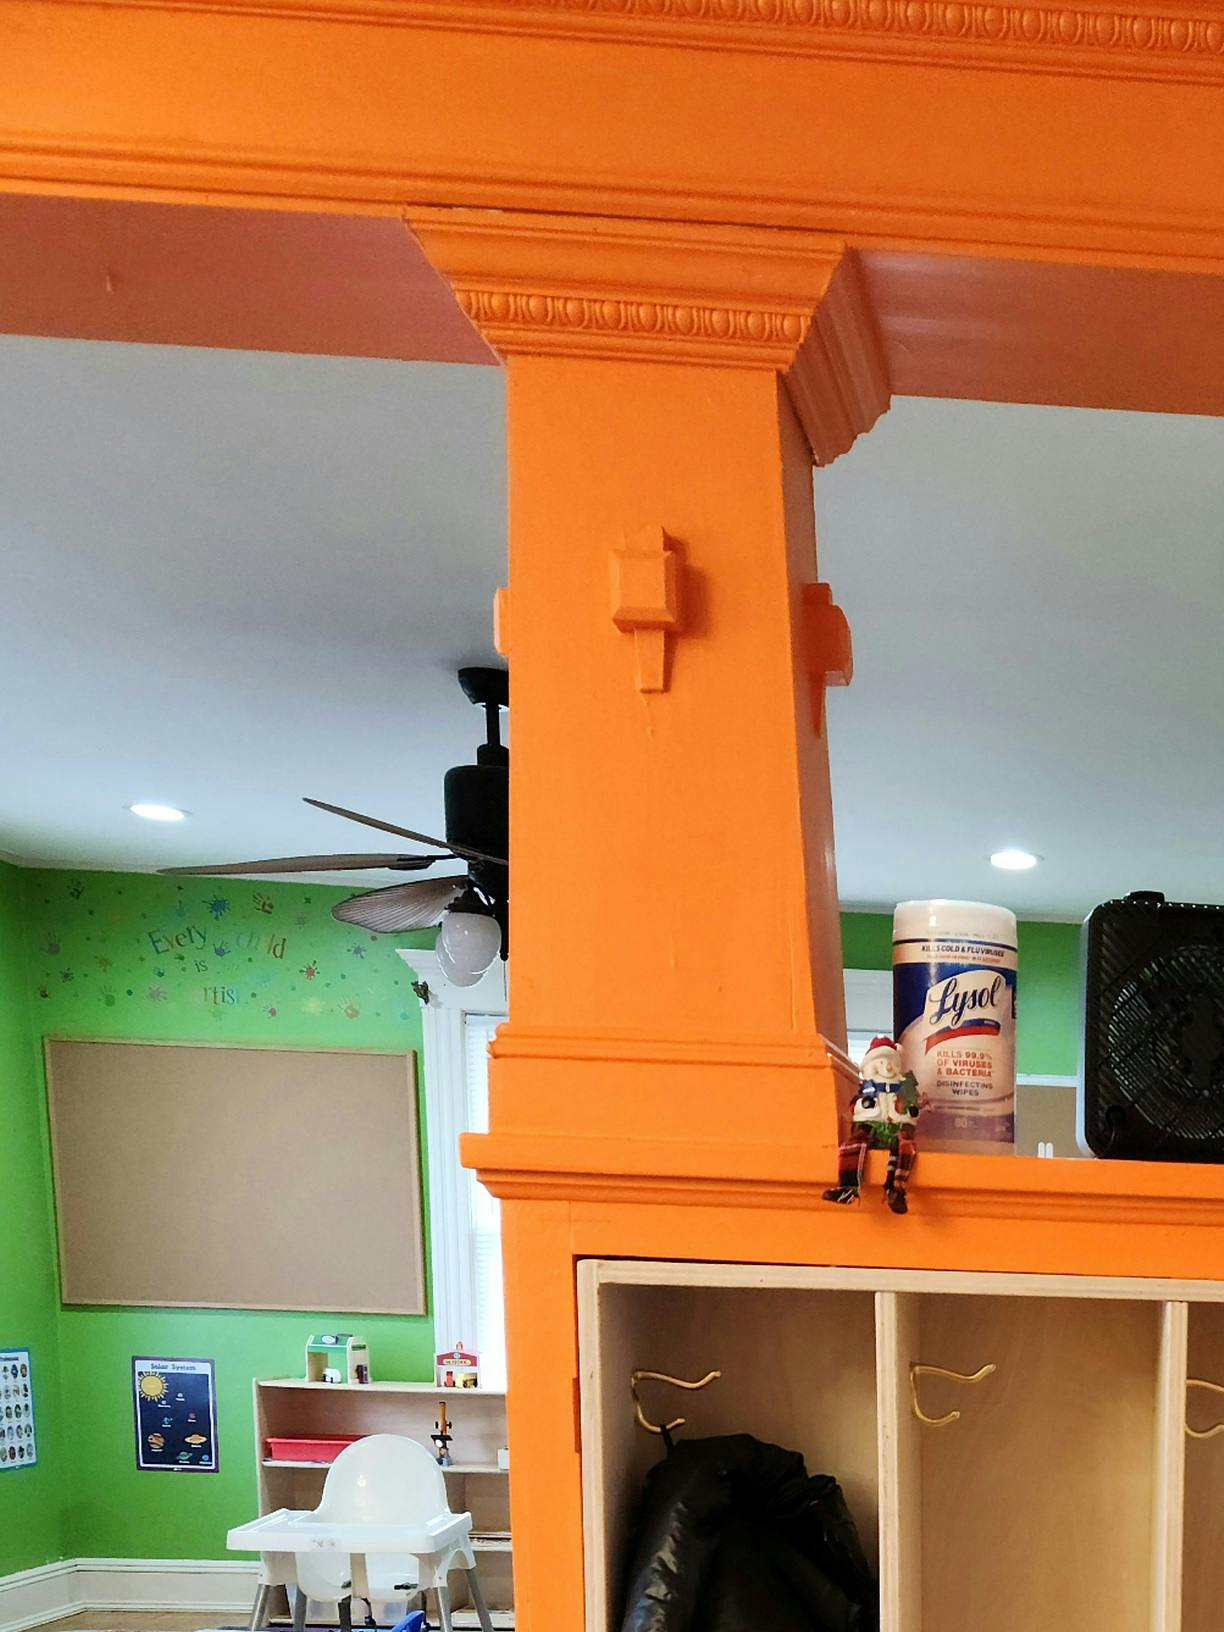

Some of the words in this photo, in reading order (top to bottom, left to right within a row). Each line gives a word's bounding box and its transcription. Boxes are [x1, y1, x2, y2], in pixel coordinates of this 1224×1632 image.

[148, 925, 207, 955] Every
[236, 931, 287, 959] chld
[941, 945, 960, 953] COLD
[961, 945, 967, 953] &
[967, 946, 981, 954] FLU
[981, 947, 1005, 957] VIRUSES
[194, 960, 209, 973] is
[200, 984, 242, 1006] rtist
[928, 976, 1001, 1025] Lysol
[937, 1050, 962, 1059] KILLS
[964, 1051, 993, 1060] 99.9%
[937, 1059, 949, 1067] OF
[952, 1059, 993, 1069] VIRUSES
[937, 1068, 943, 1076] &
[946, 1068, 992, 1077] BACTERIA
[936, 1080, 993, 1090] DISINFECTING
[952, 1088, 980, 1097] WIPES
